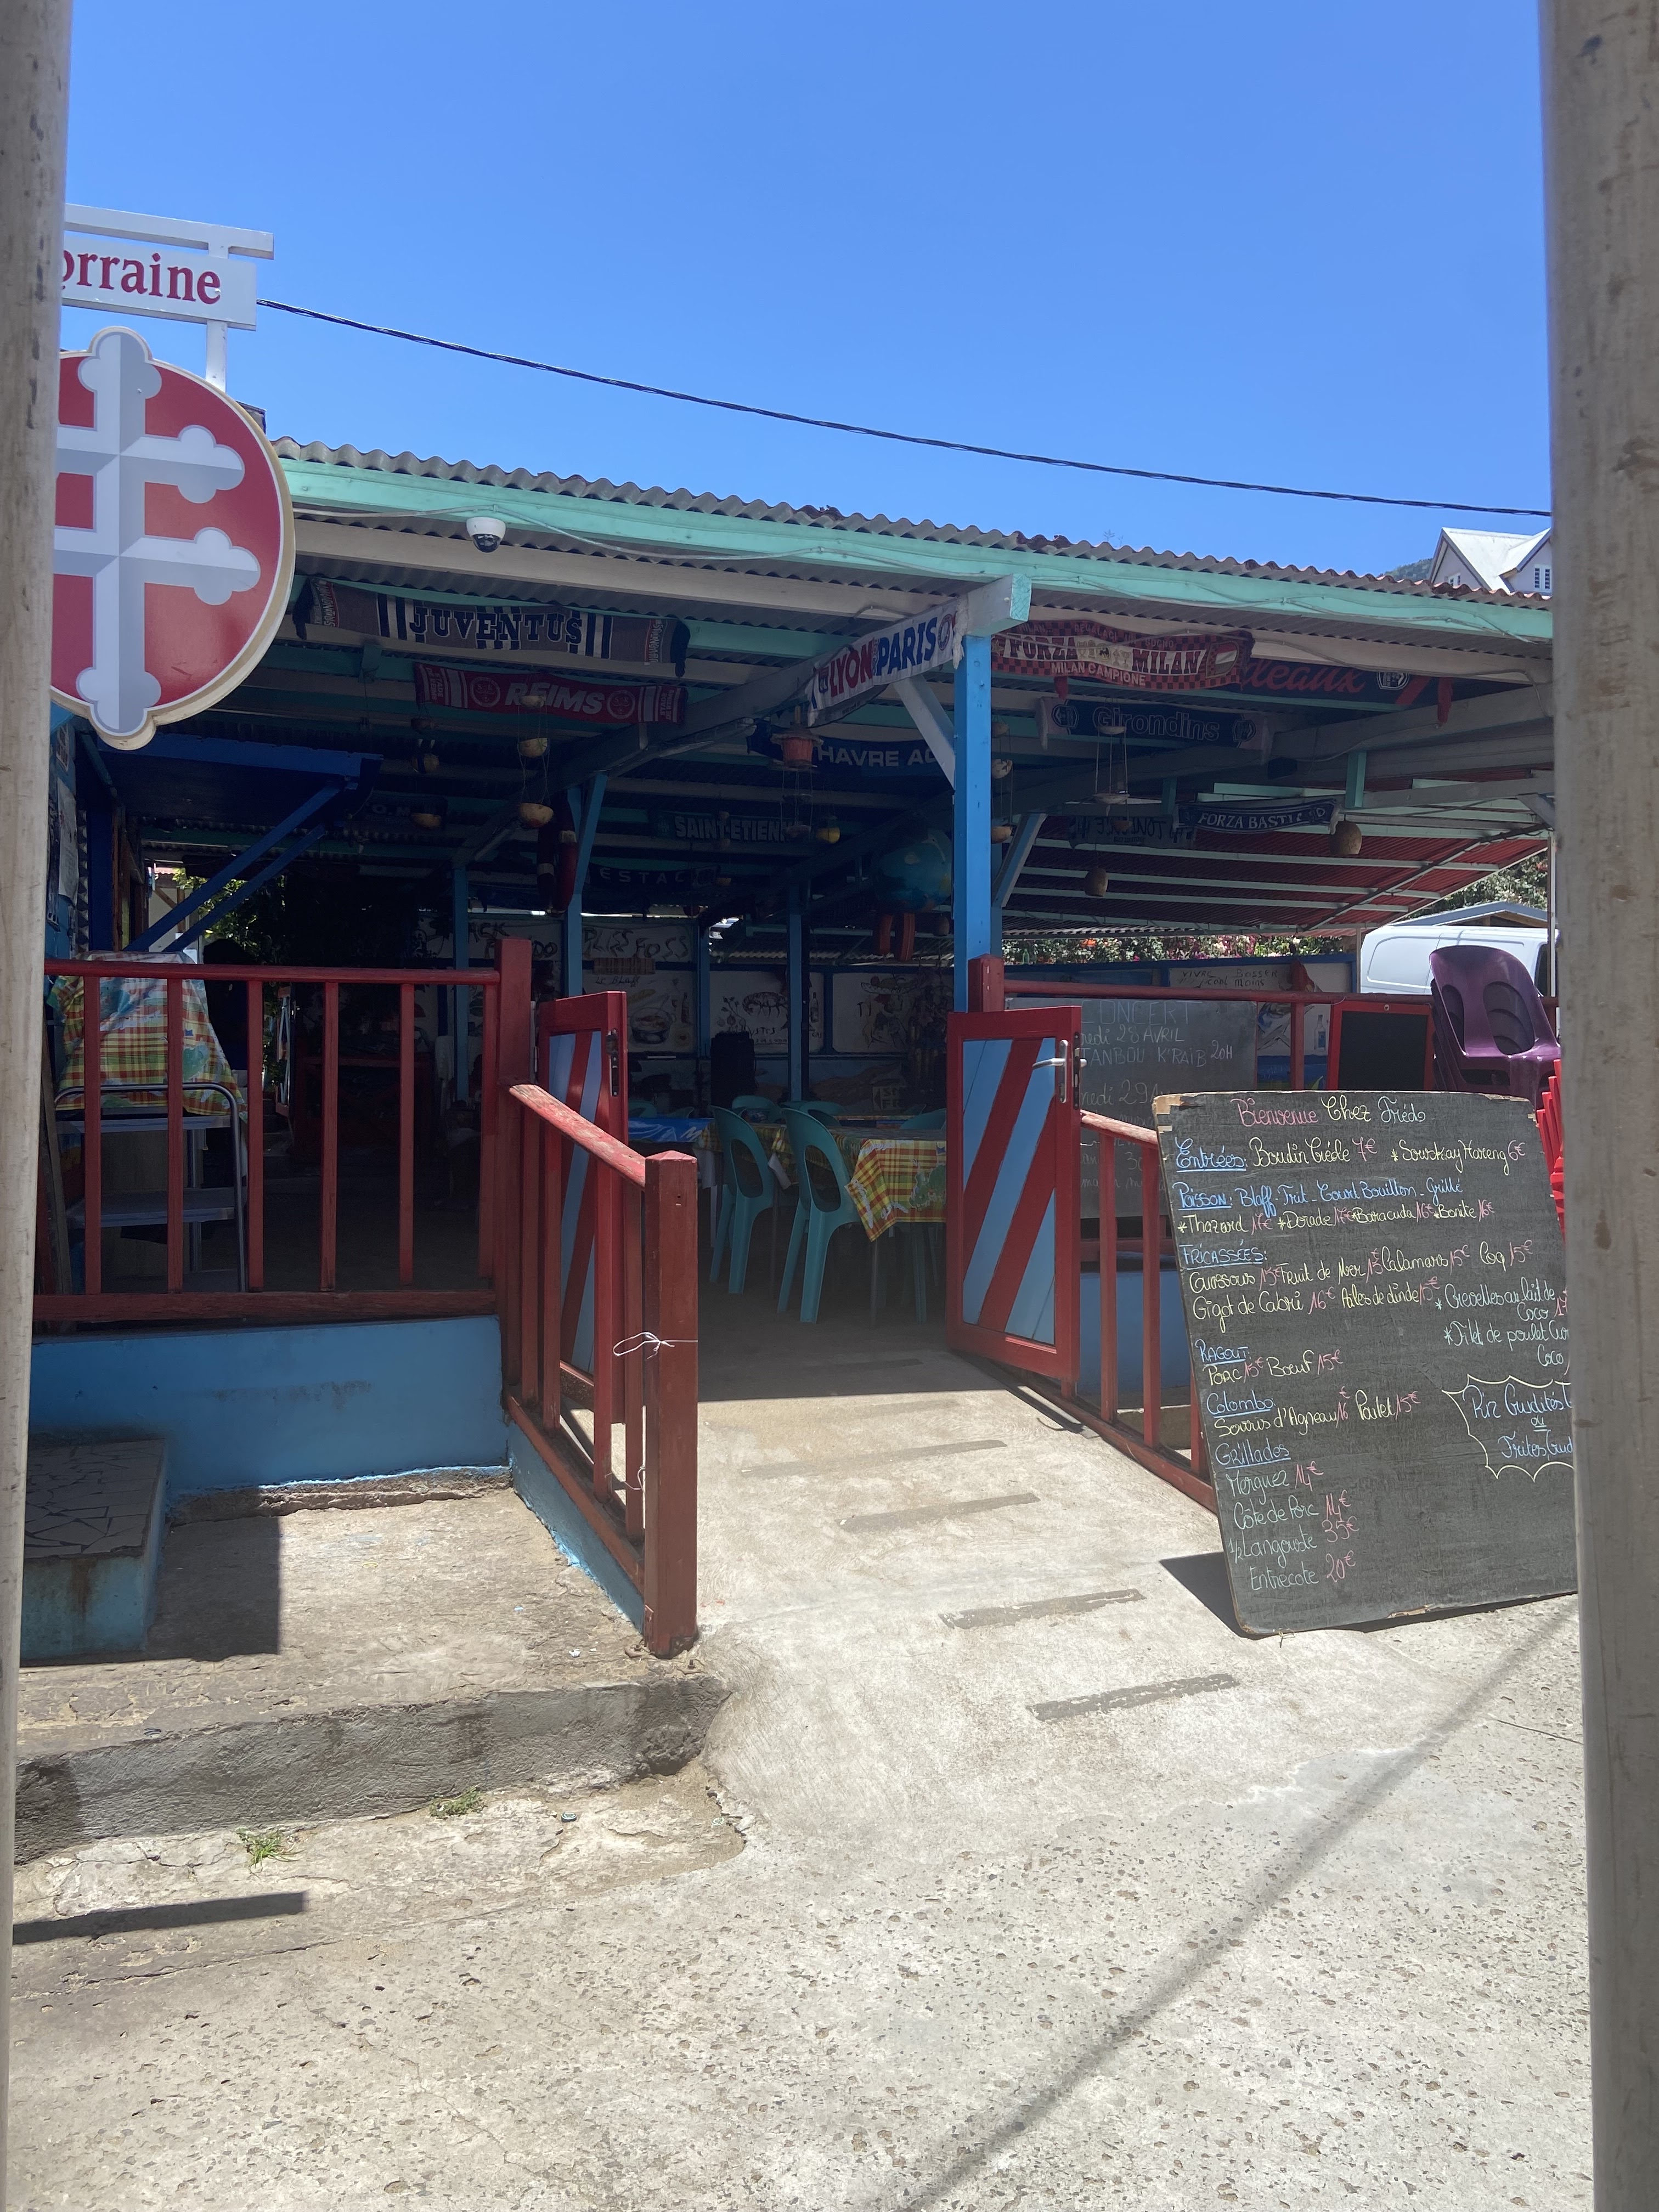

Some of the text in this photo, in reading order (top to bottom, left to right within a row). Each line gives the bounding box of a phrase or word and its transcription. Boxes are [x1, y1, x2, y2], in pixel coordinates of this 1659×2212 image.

[409, 606, 582, 644] JUVENTUS
[877, 617, 938, 676] PARIS
[1009, 636, 1077, 661] FORZA
[830, 639, 873, 698] LYON
[1051, 662, 1146, 686] MILAN CAMPIONE
[1132, 648, 1201, 675] MILAN
[504, 682, 605, 714] REIMS
[1093, 706, 1220, 742] Girondins
[816, 747, 899, 767] HAVRE
[1198, 812, 1244, 828] FORZA
[1081, 1000, 1203, 1025] CONCERT
[1143, 1025, 1185, 1043] AVRIL
[1081, 1047, 1145, 1067] TANBOU
[1231, 1098, 1318, 1127] Bienvenue
[1321, 1094, 1372, 1122] Chez
[1249, 1137, 1309, 1167] Boudin
[1438, 1200, 1477, 1218] Bonite
[1317, 1260, 1331, 1281] de
[1192, 1294, 1234, 1334] Gigot
[1237, 1294, 1256, 1315] de
[1517, 1301, 1549, 1322] Coco
[1486, 1322, 1503, 1343] de
[1537, 1344, 1564, 1367] Coco
[1267, 1498, 1289, 1523] de
